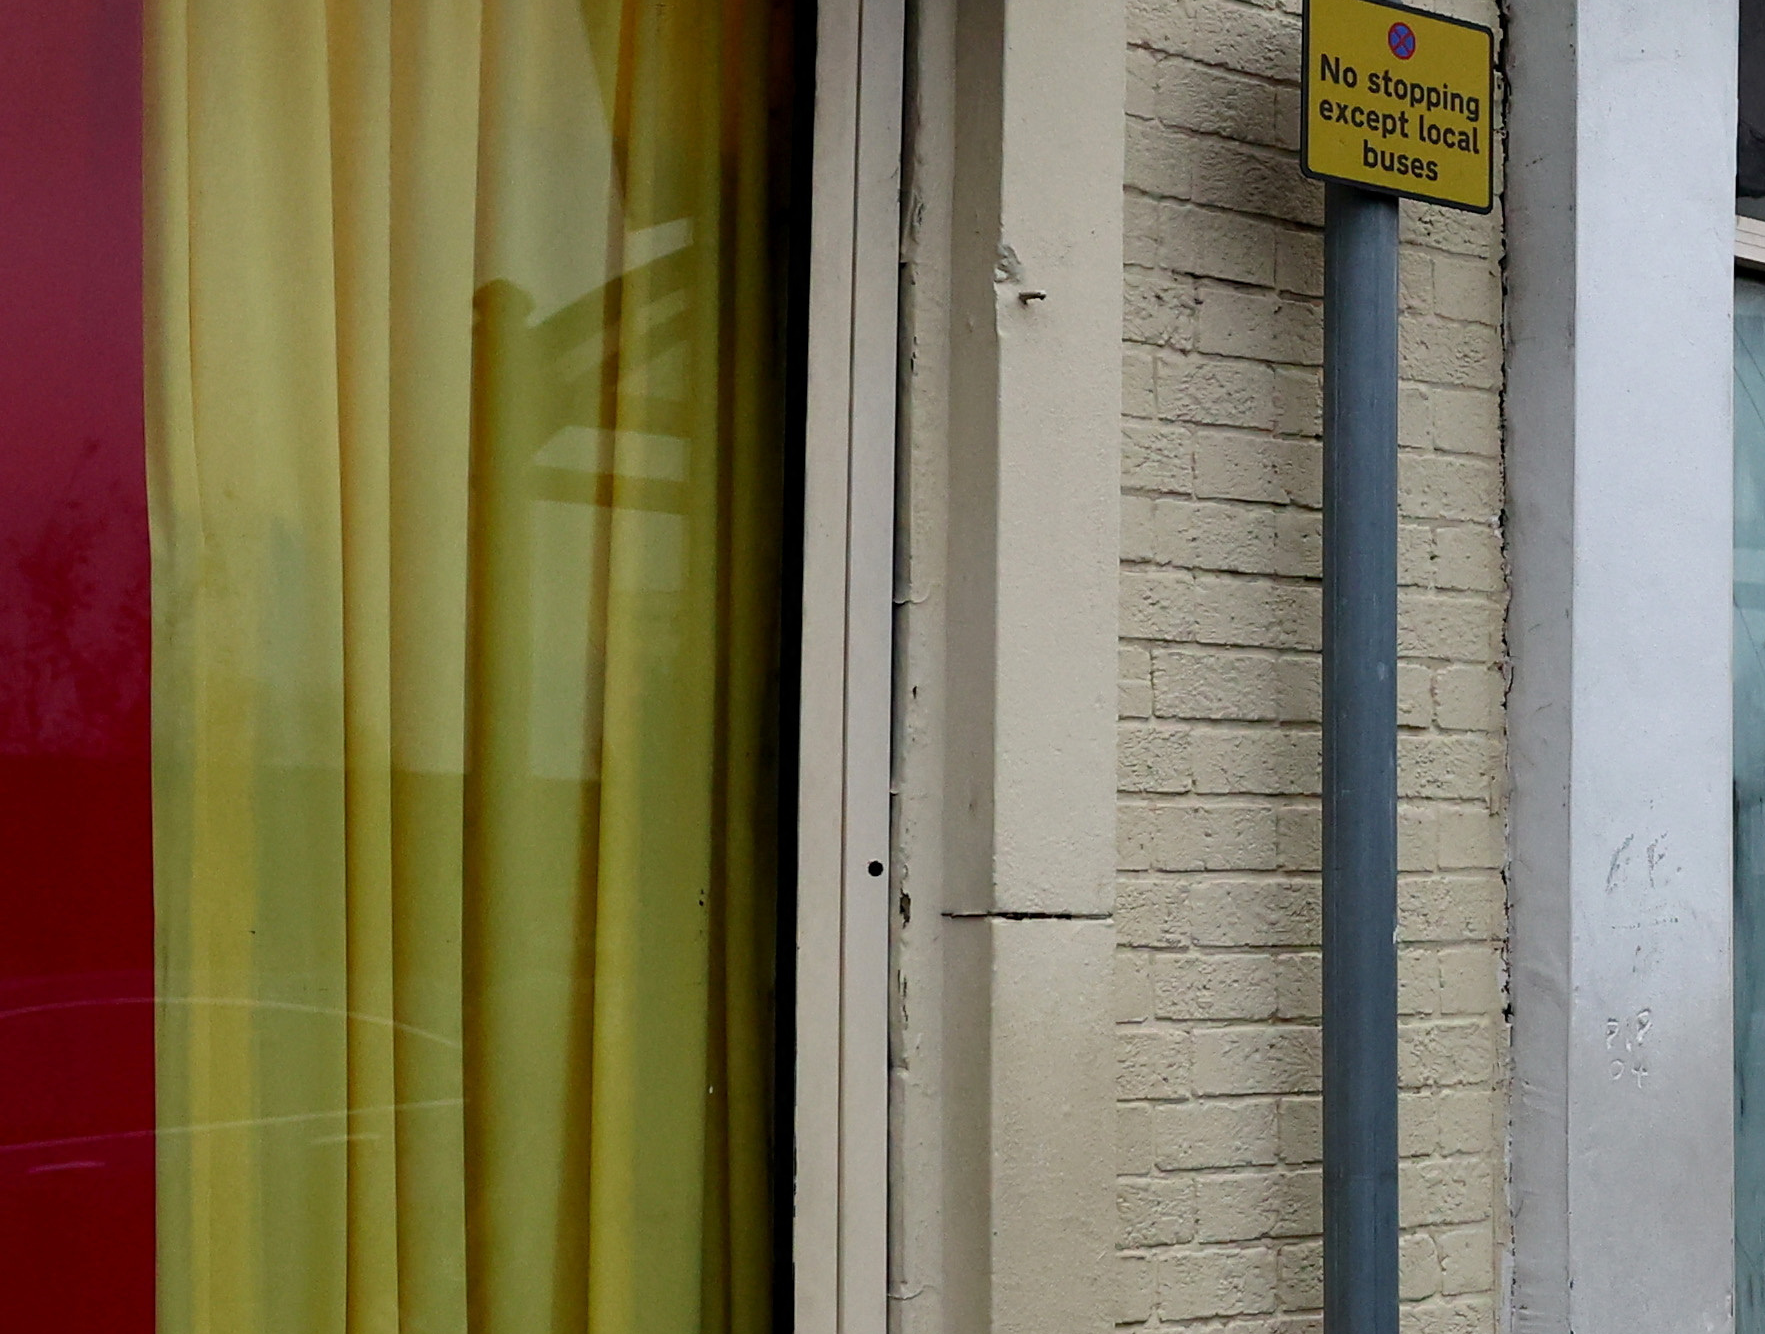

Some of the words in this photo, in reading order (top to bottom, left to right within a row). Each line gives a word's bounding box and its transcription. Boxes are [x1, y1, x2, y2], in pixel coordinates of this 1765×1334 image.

[1320, 53, 1358, 88] No
[1367, 68, 1480, 123] stopping
[1319, 98, 1409, 139] except
[1418, 114, 1480, 154] local
[1363, 139, 1439, 182] buses
